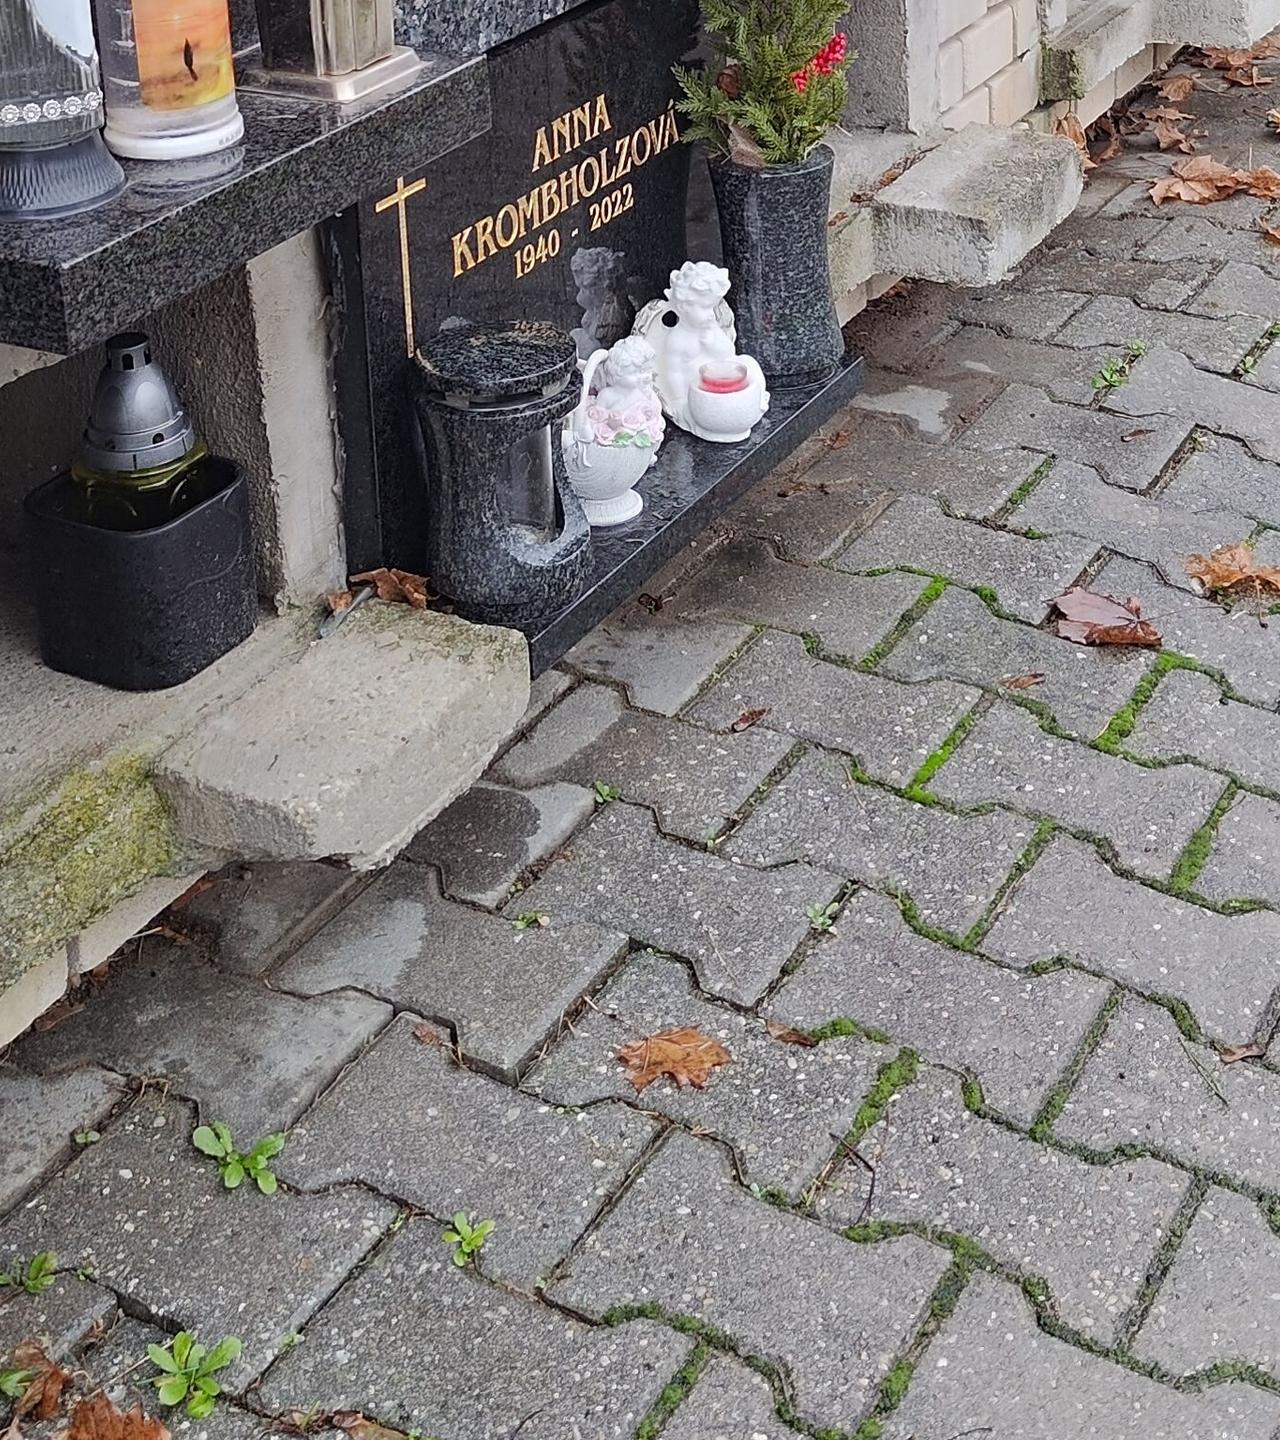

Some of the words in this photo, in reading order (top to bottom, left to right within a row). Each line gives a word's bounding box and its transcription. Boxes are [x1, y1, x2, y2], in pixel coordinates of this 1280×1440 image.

[531, 92, 612, 174] ANNA
[451, 97, 681, 280] KROMBHOLZOVÁ
[513, 231, 562, 281] 1940
[588, 182, 635, 233] 2022
